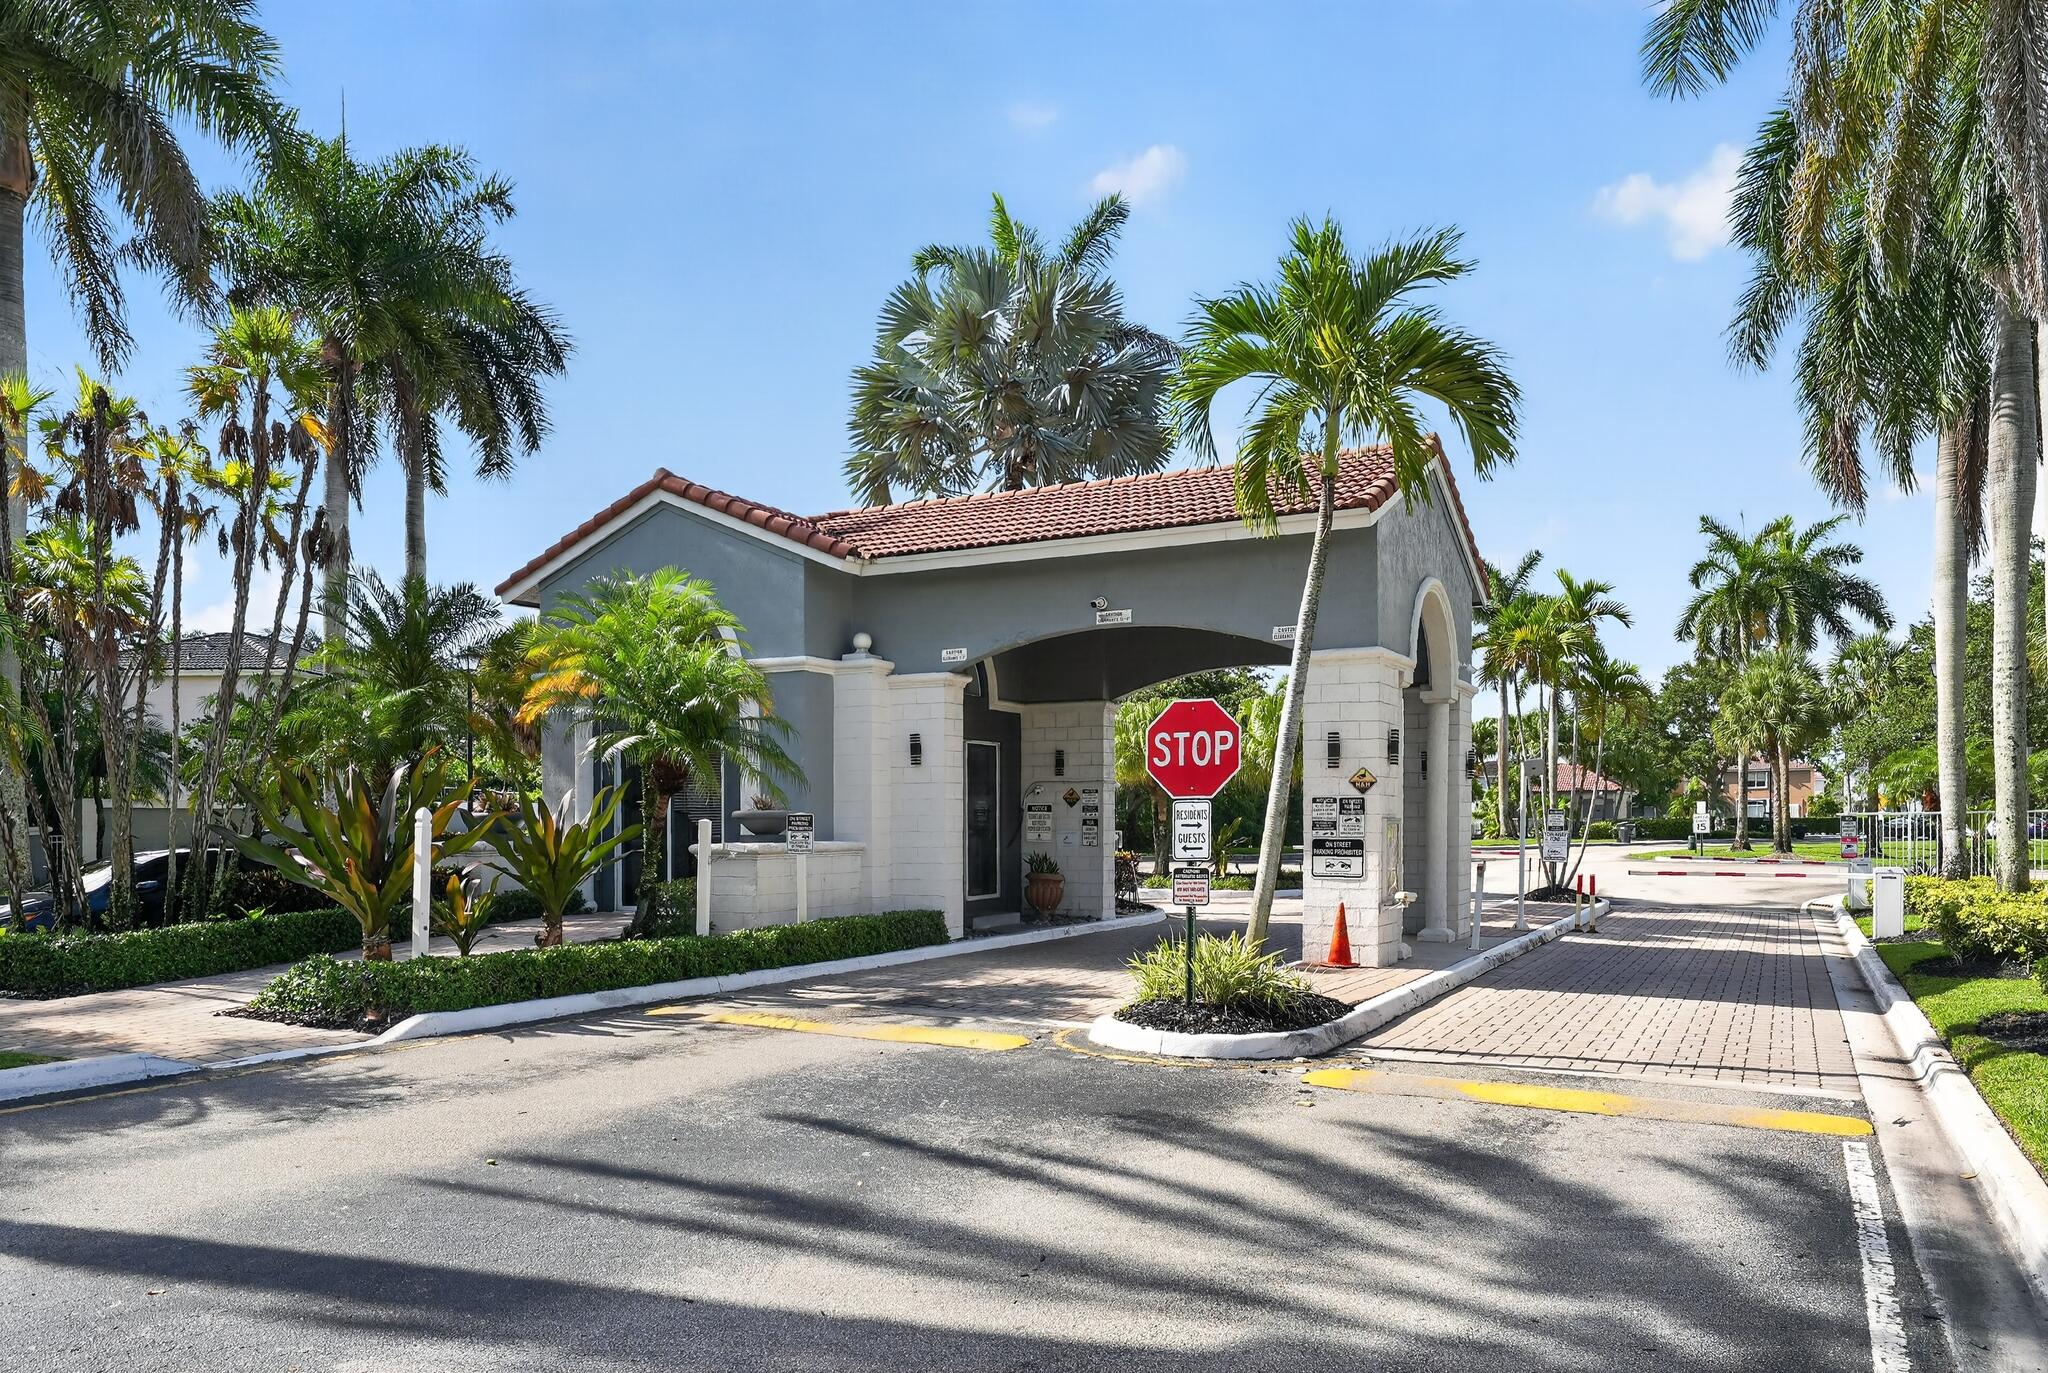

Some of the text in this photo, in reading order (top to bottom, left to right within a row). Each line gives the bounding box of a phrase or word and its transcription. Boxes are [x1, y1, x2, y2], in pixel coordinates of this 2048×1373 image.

[1153, 730, 1234, 767] STOP
[1176, 809, 1208, 820] RESIDENTS
[1696, 823, 1707, 831] 15
[1178, 832, 1206, 844] GUESTS
[1334, 848, 1363, 856] PROHIBITED
